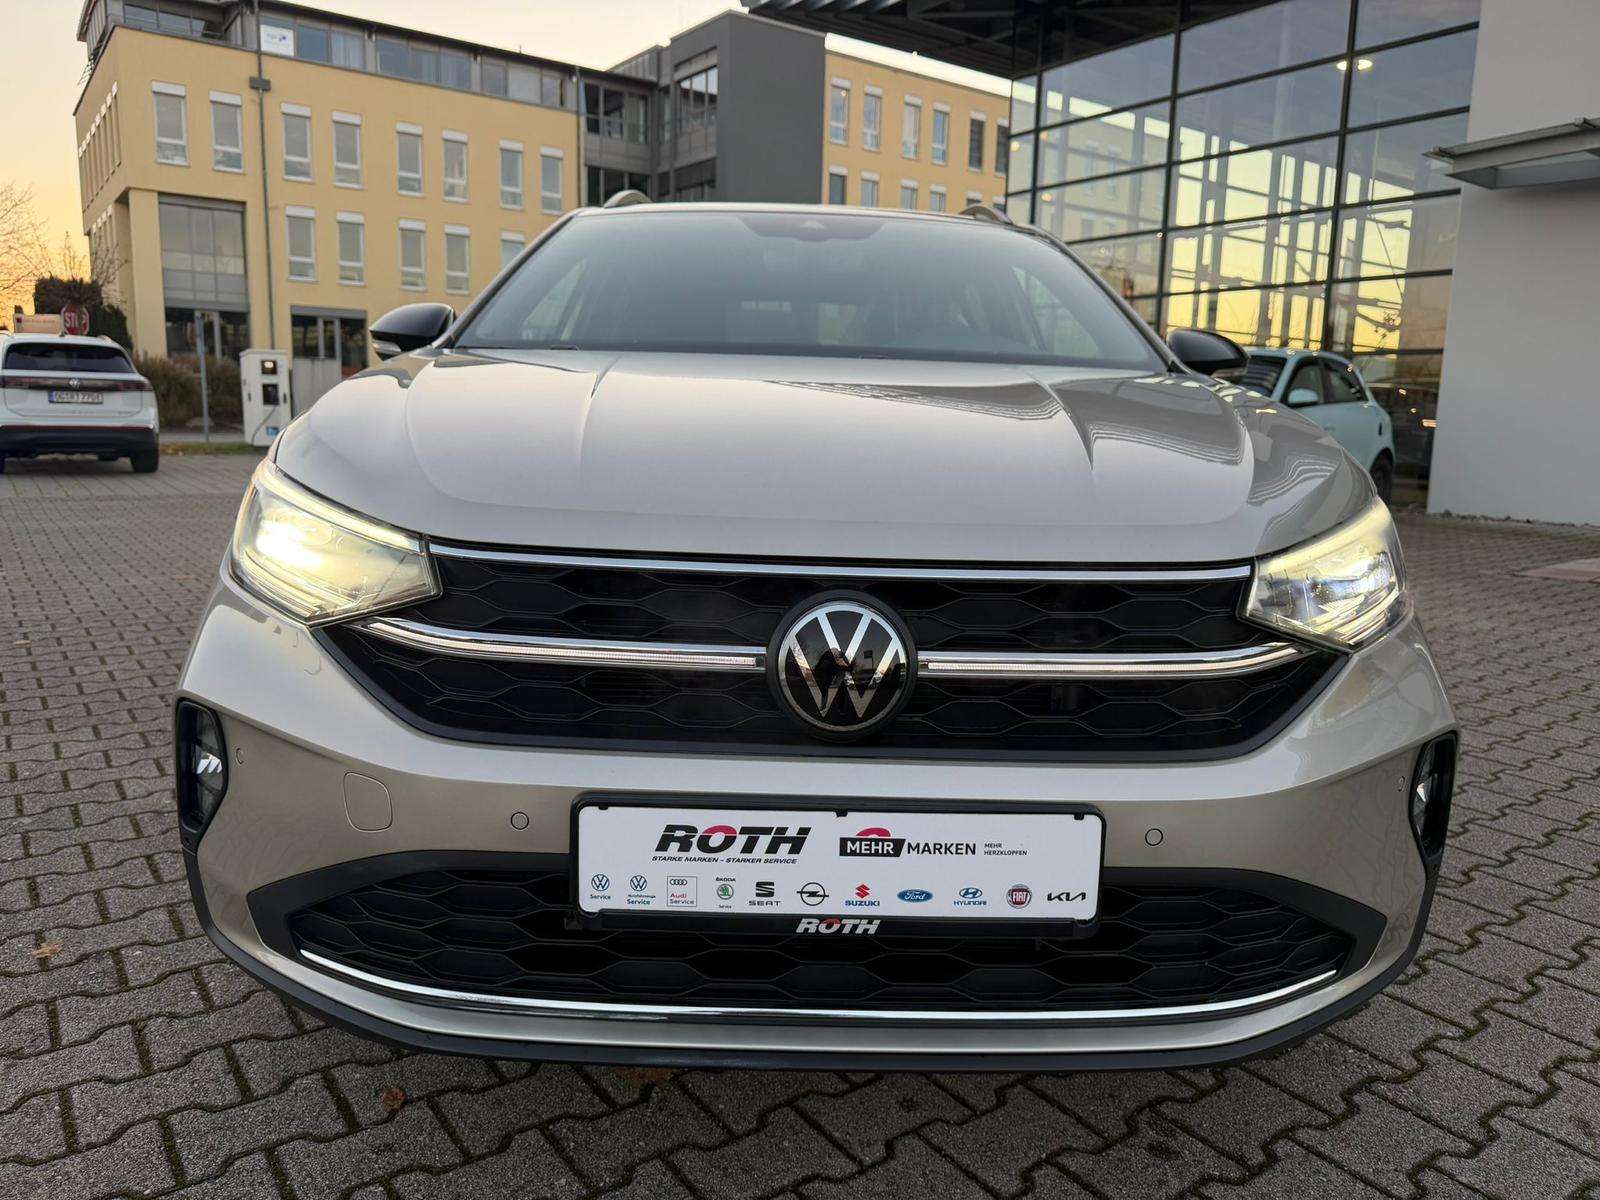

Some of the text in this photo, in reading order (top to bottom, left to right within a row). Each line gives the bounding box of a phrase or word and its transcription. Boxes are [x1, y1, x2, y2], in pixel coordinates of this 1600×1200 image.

[654, 824, 812, 855] ROTH
[846, 840, 977, 856] MEHR MARKEN
[1046, 891, 1086, 902] KIA
[795, 918, 882, 935] ROTH
